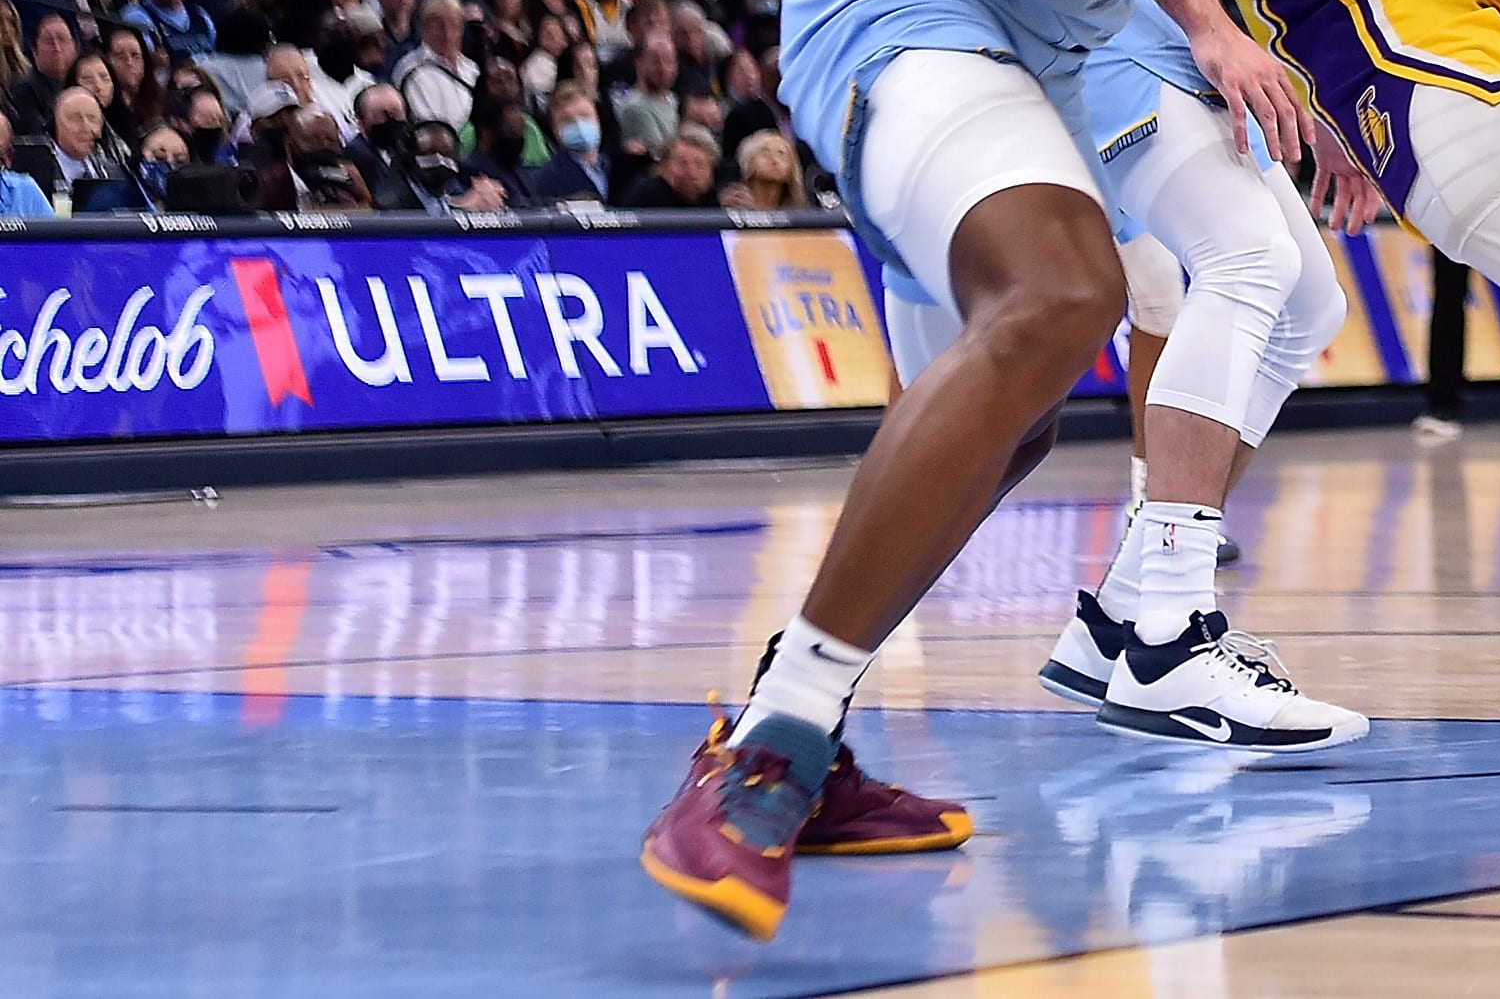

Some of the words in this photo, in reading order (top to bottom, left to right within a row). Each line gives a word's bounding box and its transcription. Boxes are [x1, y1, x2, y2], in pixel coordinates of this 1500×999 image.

[0, 285, 215, 395] chelob
[315, 270, 700, 387] ULTRA
[759, 291, 866, 339] ULTRA
